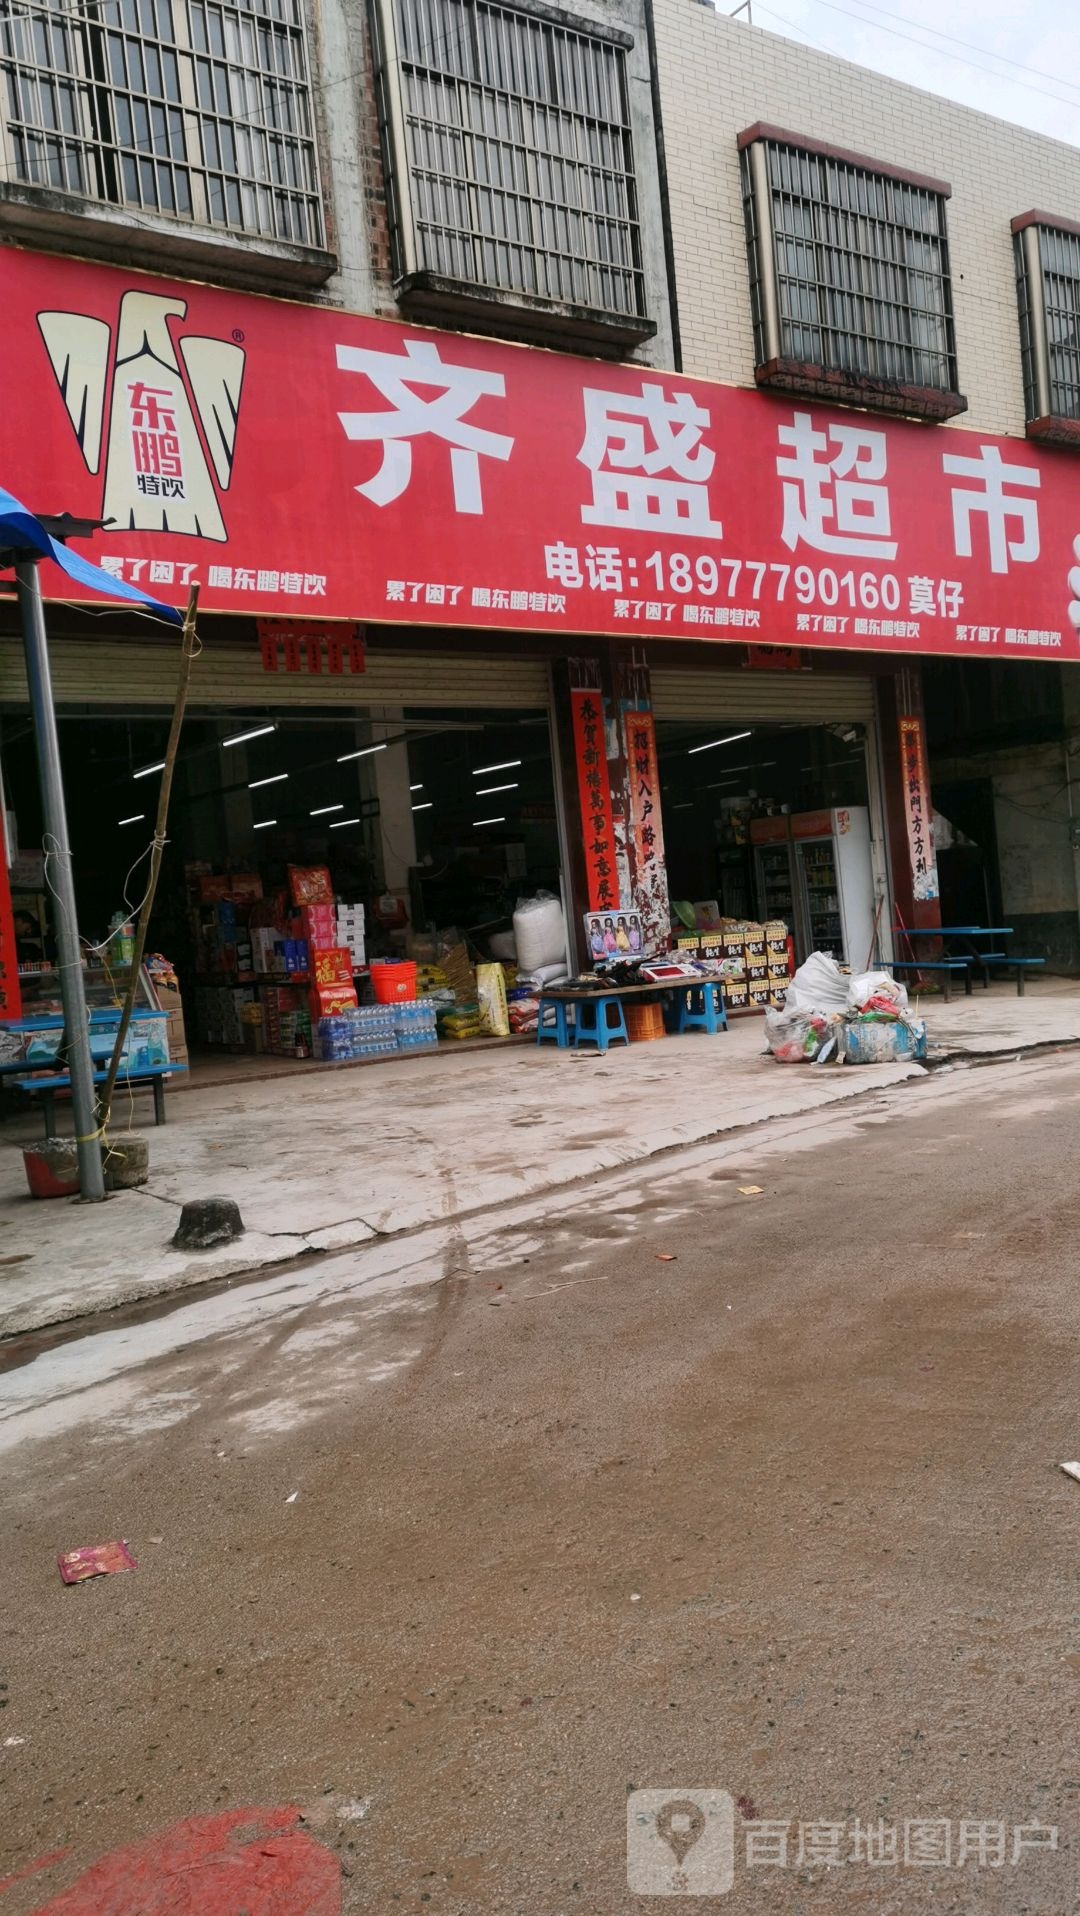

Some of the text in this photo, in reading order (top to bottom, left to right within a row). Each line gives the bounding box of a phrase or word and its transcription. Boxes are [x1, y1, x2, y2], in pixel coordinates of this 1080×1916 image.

[128, 382, 182, 477] 东鹏
[335, 338, 1042, 575] 齐盛超市
[137, 474, 185, 498] 特饮
[208, 566, 327, 596] 喝东鹏特饮
[386, 580, 566, 614] 累了困了 喝东鹏特饮
[908, 576, 964, 619] 莫仔
[614, 599, 760, 628] 累了困了 喝东鹏特饮
[796, 613, 849, 633] 累了困了
[956, 624, 1000, 642] 累了困了
